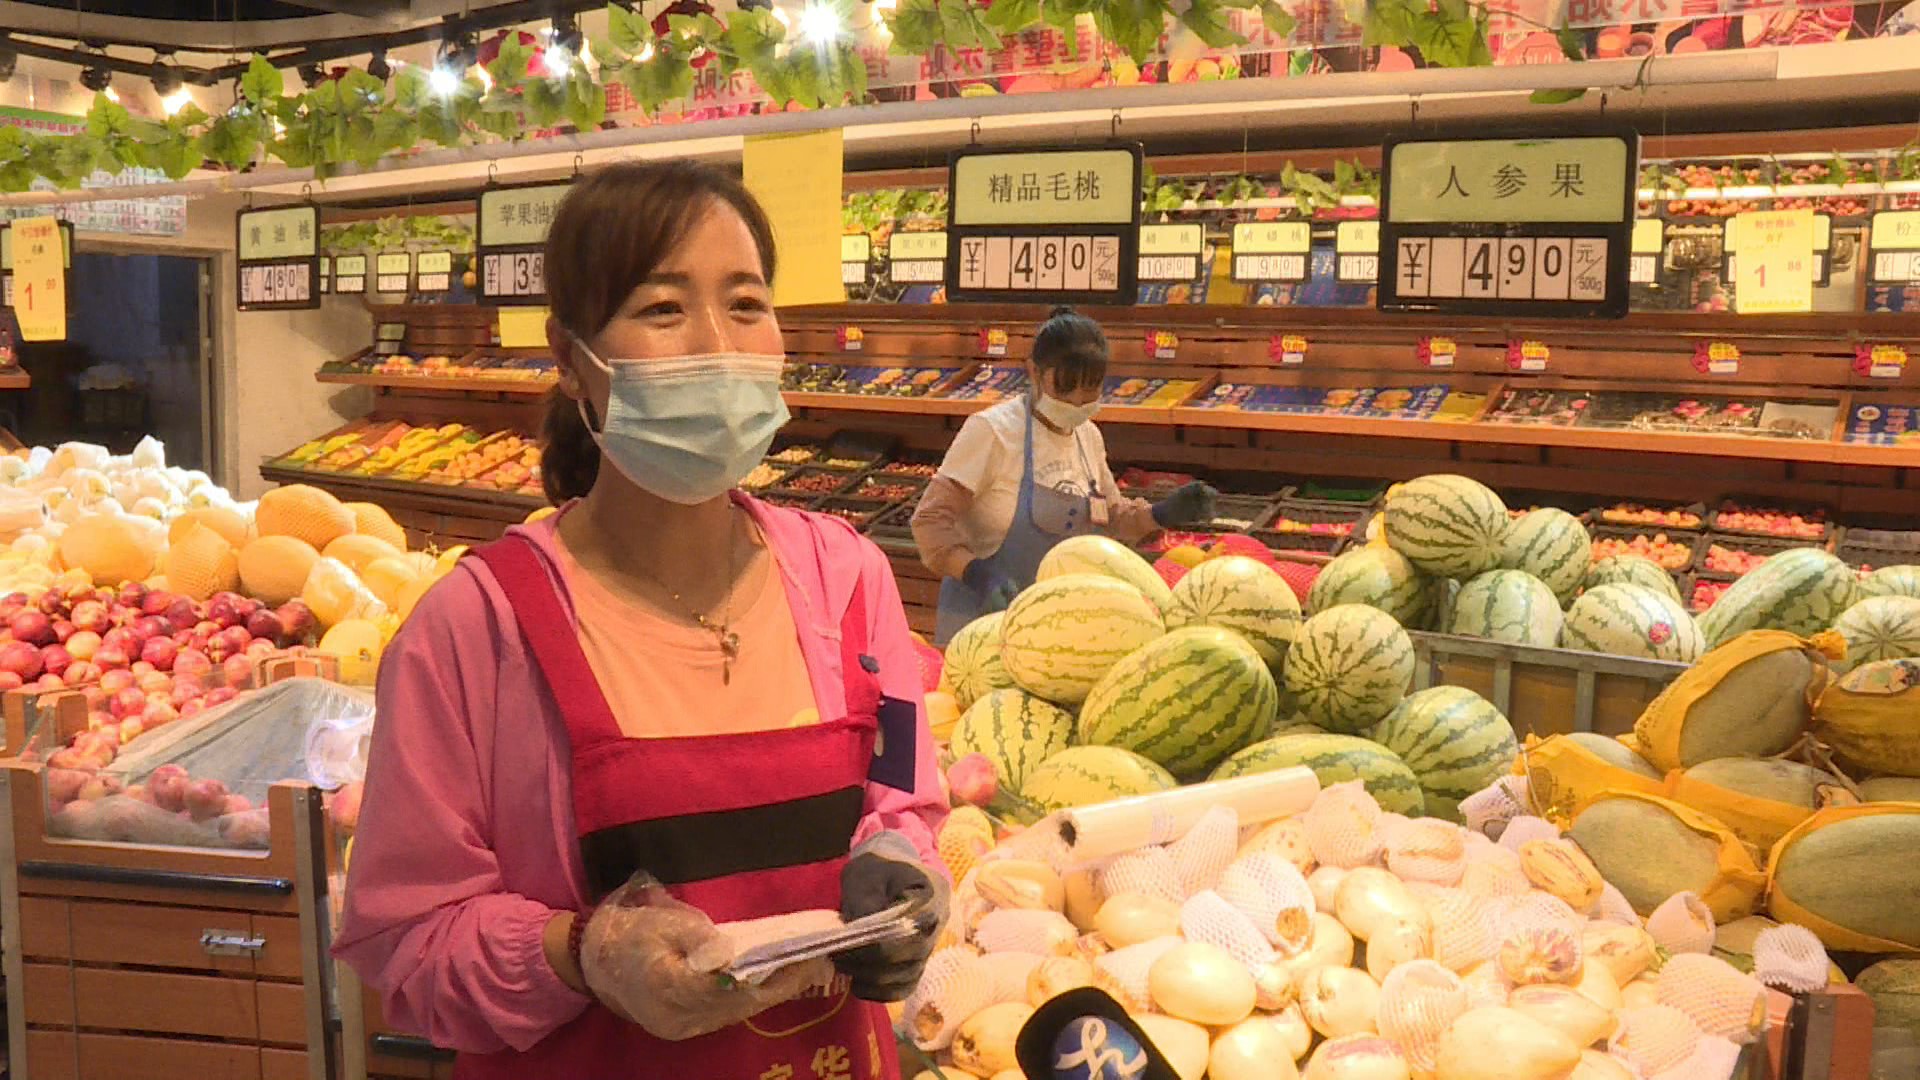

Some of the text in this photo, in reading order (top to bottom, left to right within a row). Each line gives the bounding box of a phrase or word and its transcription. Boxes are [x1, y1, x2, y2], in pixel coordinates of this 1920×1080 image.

[989, 170, 1101, 203] 精品毛桃
[1437, 162, 1584, 199] 人参果
[500, 200, 557, 227] 苹果油
[518, 257, 543, 290] 3.8
[1014, 242, 1086, 283] 4.80
[1467, 243, 1562, 291] 4.90
